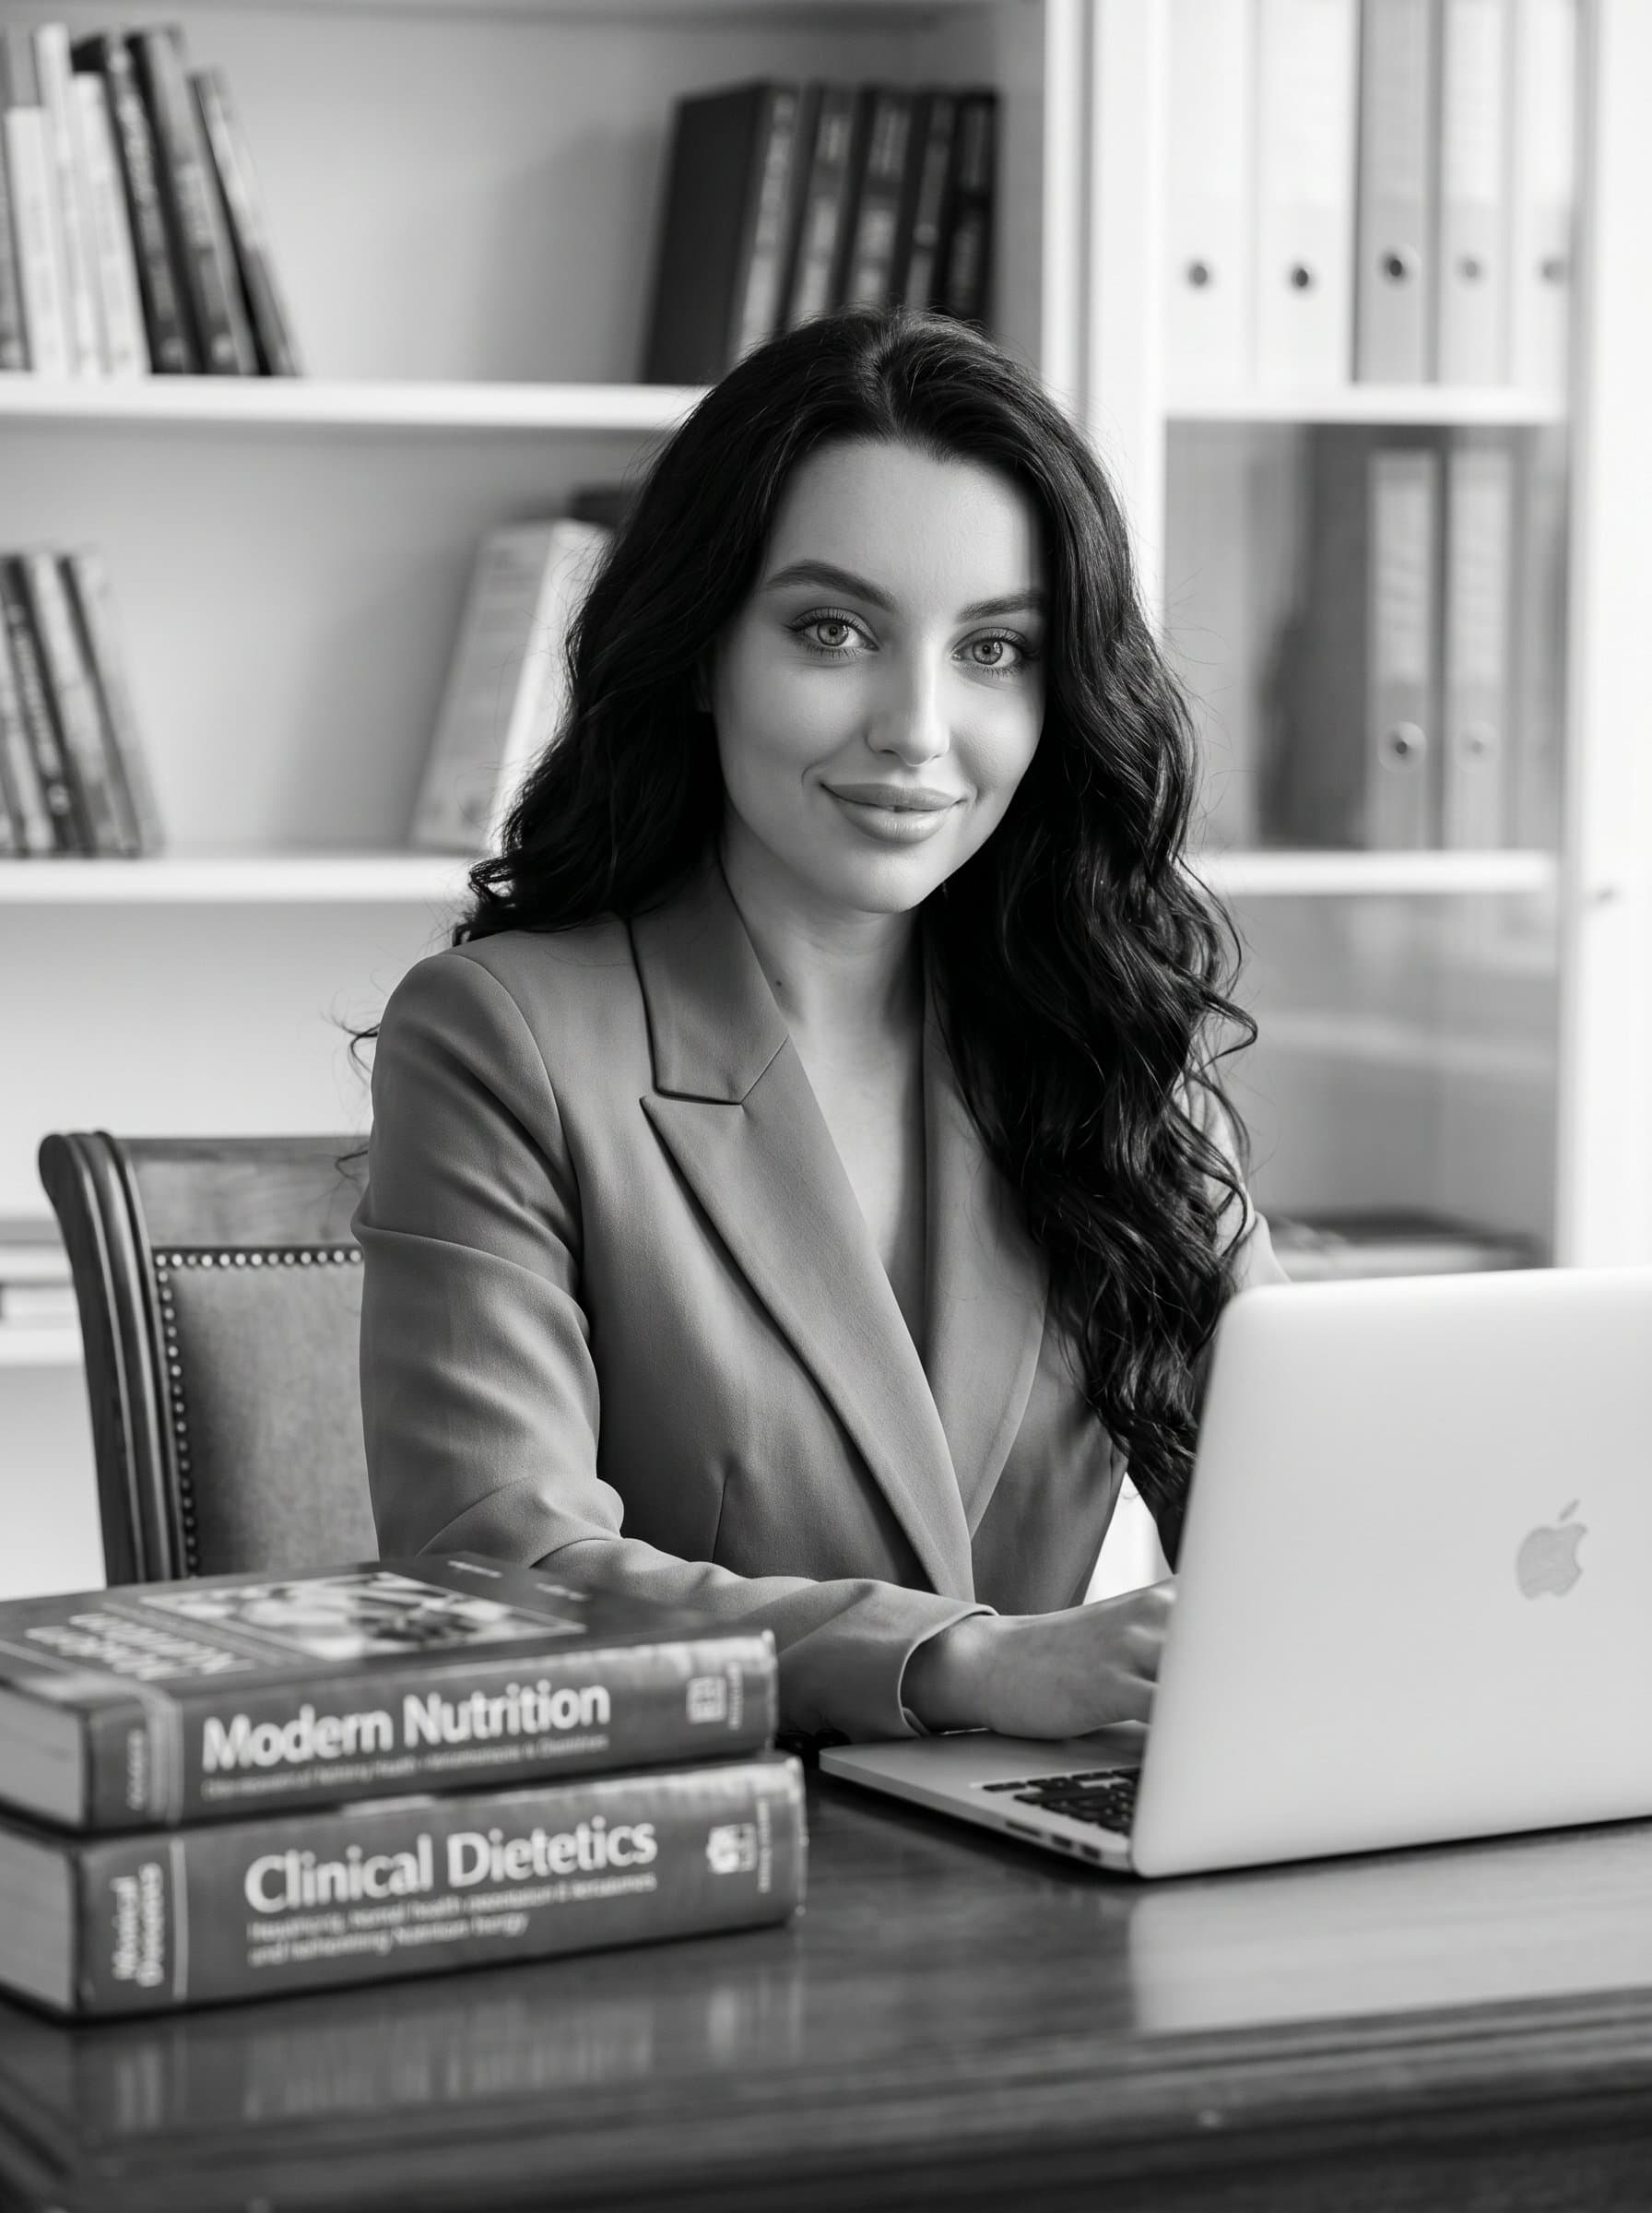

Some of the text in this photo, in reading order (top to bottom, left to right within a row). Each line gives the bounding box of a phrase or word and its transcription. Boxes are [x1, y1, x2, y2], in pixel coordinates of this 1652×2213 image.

[202, 1703, 394, 1773] Modern
[403, 1678, 610, 1748] Nutrition
[244, 1832, 433, 1914] Clinical
[446, 1815, 658, 1888] Dietetics
